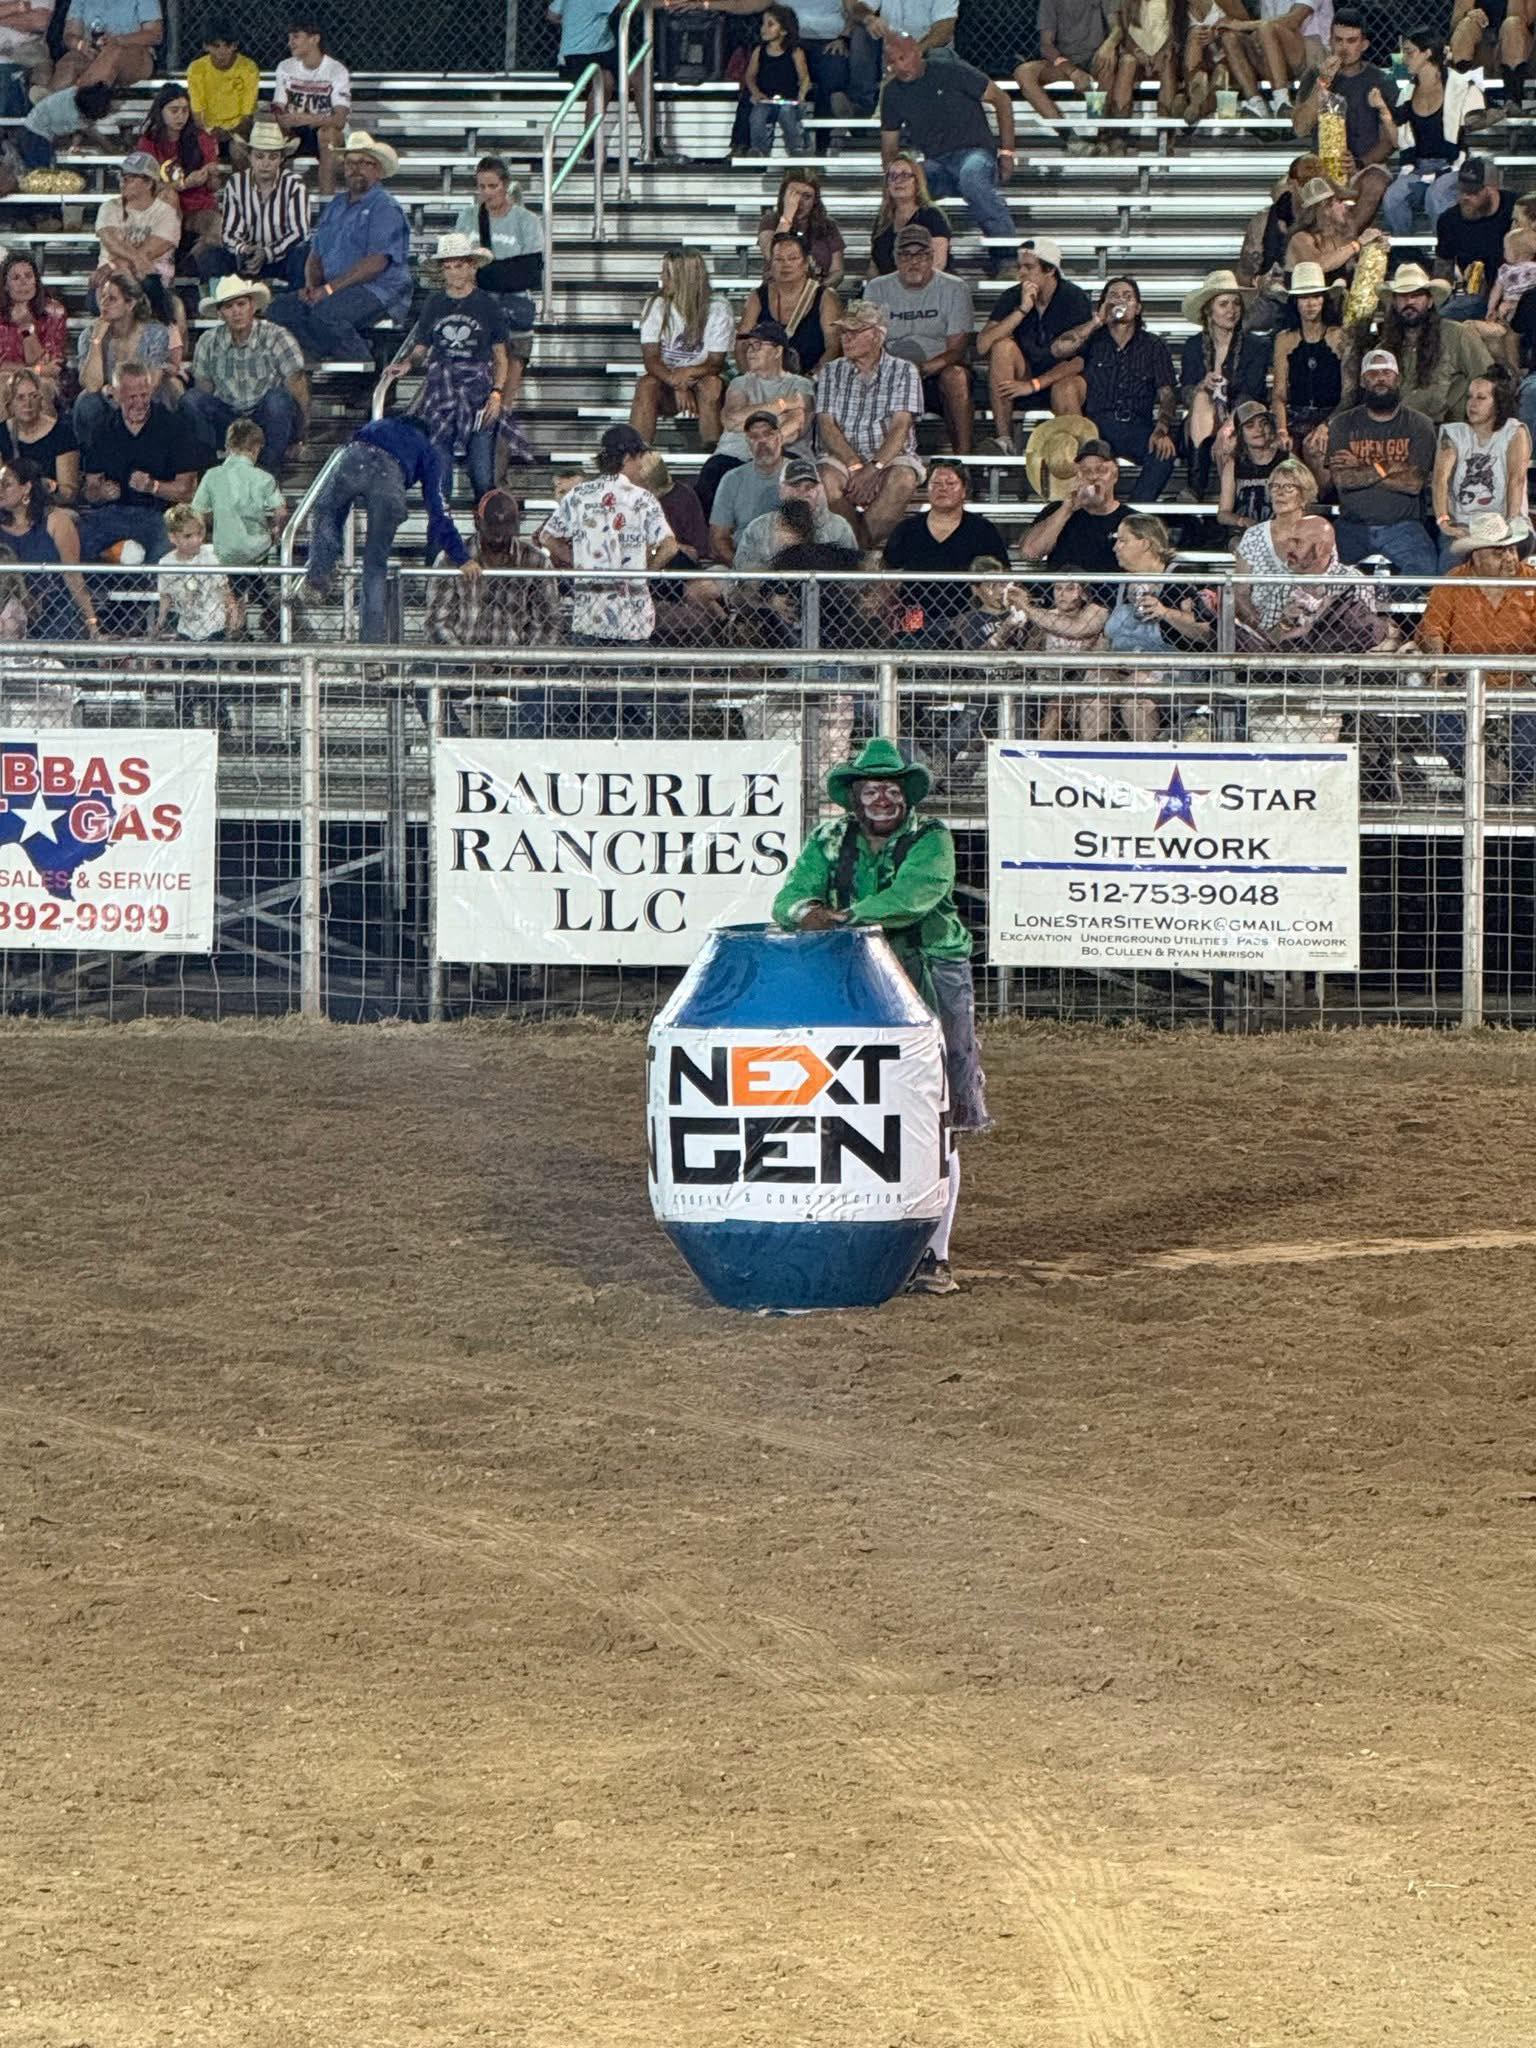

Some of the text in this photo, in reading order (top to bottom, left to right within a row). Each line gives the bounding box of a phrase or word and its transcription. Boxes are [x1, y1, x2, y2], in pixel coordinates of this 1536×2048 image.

[889, 309, 938, 320] HEAD
[455, 769, 784, 816] BAUERLE
[1219, 784, 1317, 811] STAR
[71, 802, 183, 842] GAS
[450, 828, 788, 875] RANCHES
[1074, 831, 1271, 859] SITEWORK
[0, 869, 191, 890] SALES & SERVICE
[1068, 882, 1279, 905] 512-753-9048
[553, 888, 686, 933] LLC
[1000, 932, 1072, 942] EXCAVATION
[1081, 934, 1171, 944] UNDERGROUND
[1174, 936, 1228, 946] UTILITIES
[1278, 937, 1347, 947] ROADWORK
[1105, 947, 1151, 956] CULLEN
[1155, 948, 1164, 957] &
[1167, 948, 1199, 958] RYAN
[1202, 949, 1264, 959] HARRISON
[669, 1045, 901, 1107] NEXT
[670, 1115, 901, 1184] GEN
[766, 1193, 902, 1206] CONSTRUCTION
